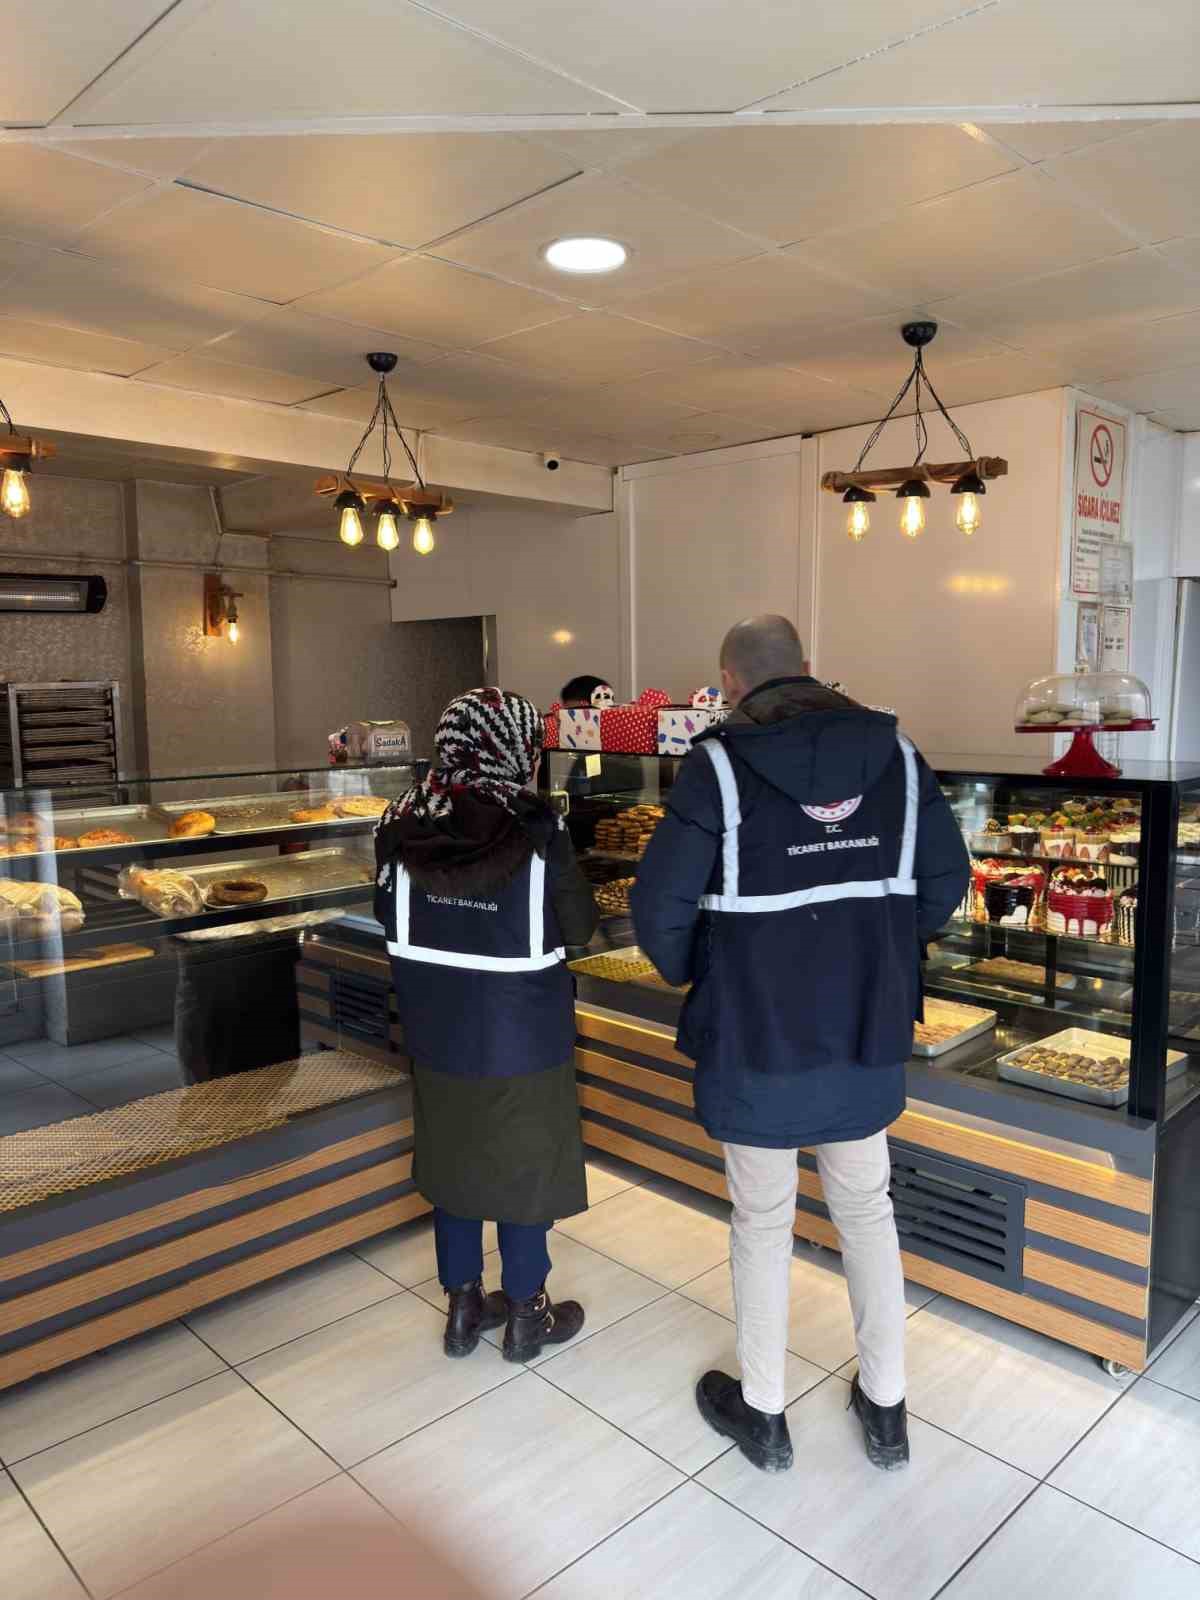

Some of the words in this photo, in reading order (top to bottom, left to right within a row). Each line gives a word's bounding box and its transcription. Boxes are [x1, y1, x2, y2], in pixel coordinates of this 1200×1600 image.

[786, 842, 826, 856] TİCARET
[826, 836, 879, 850] BAKANLIĞI
[425, 894, 458, 905] TİCARET
[457, 898, 498, 912] BAKANLIĞI
